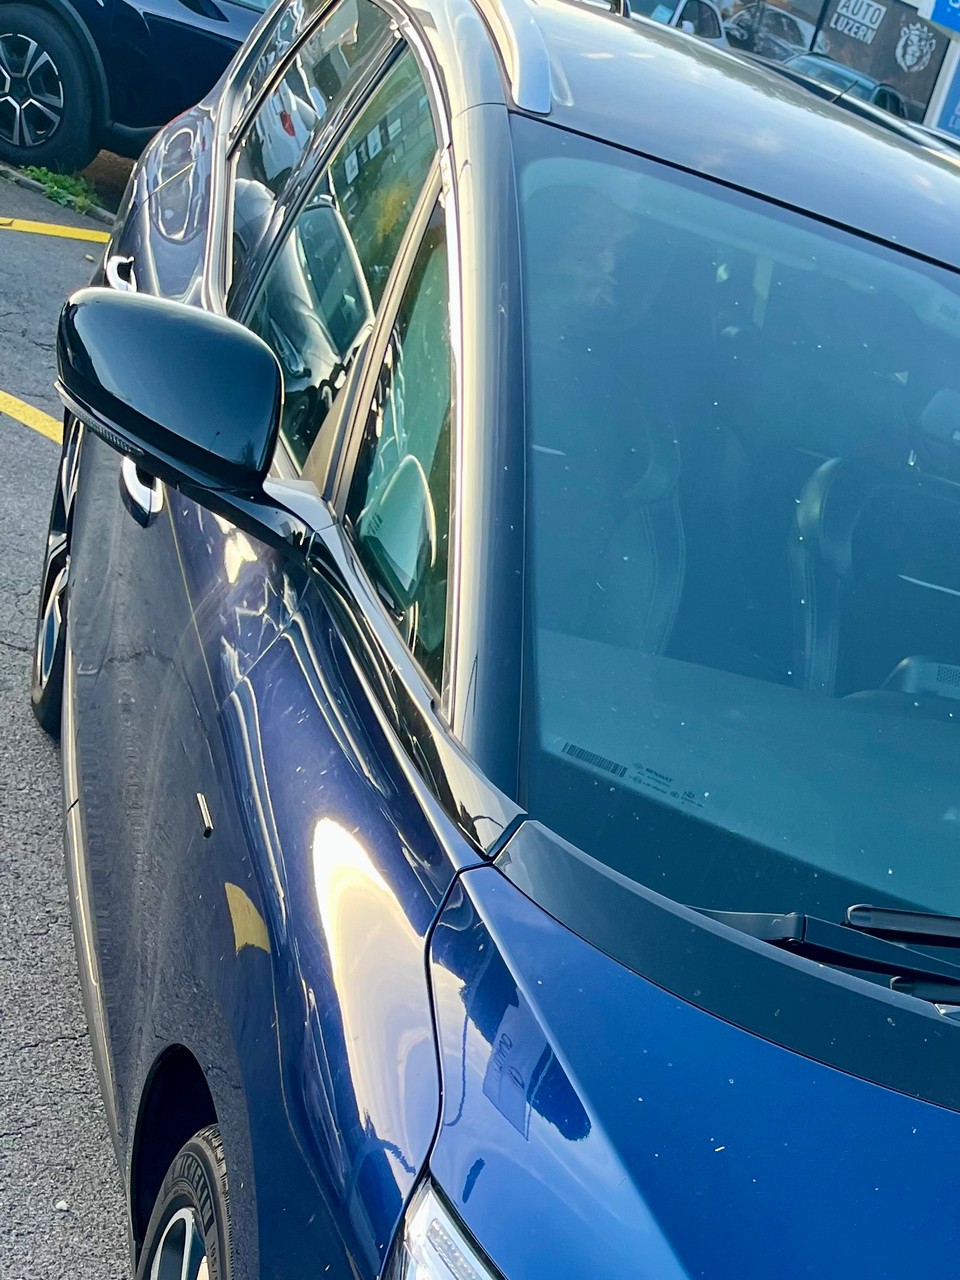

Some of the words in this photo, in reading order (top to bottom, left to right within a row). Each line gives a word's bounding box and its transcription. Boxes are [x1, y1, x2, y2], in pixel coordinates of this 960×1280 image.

[829, 12, 877, 45] LUZERN
[839, 0, 882, 25] AUTO
[173, 1155, 213, 1226] MICHELIN
